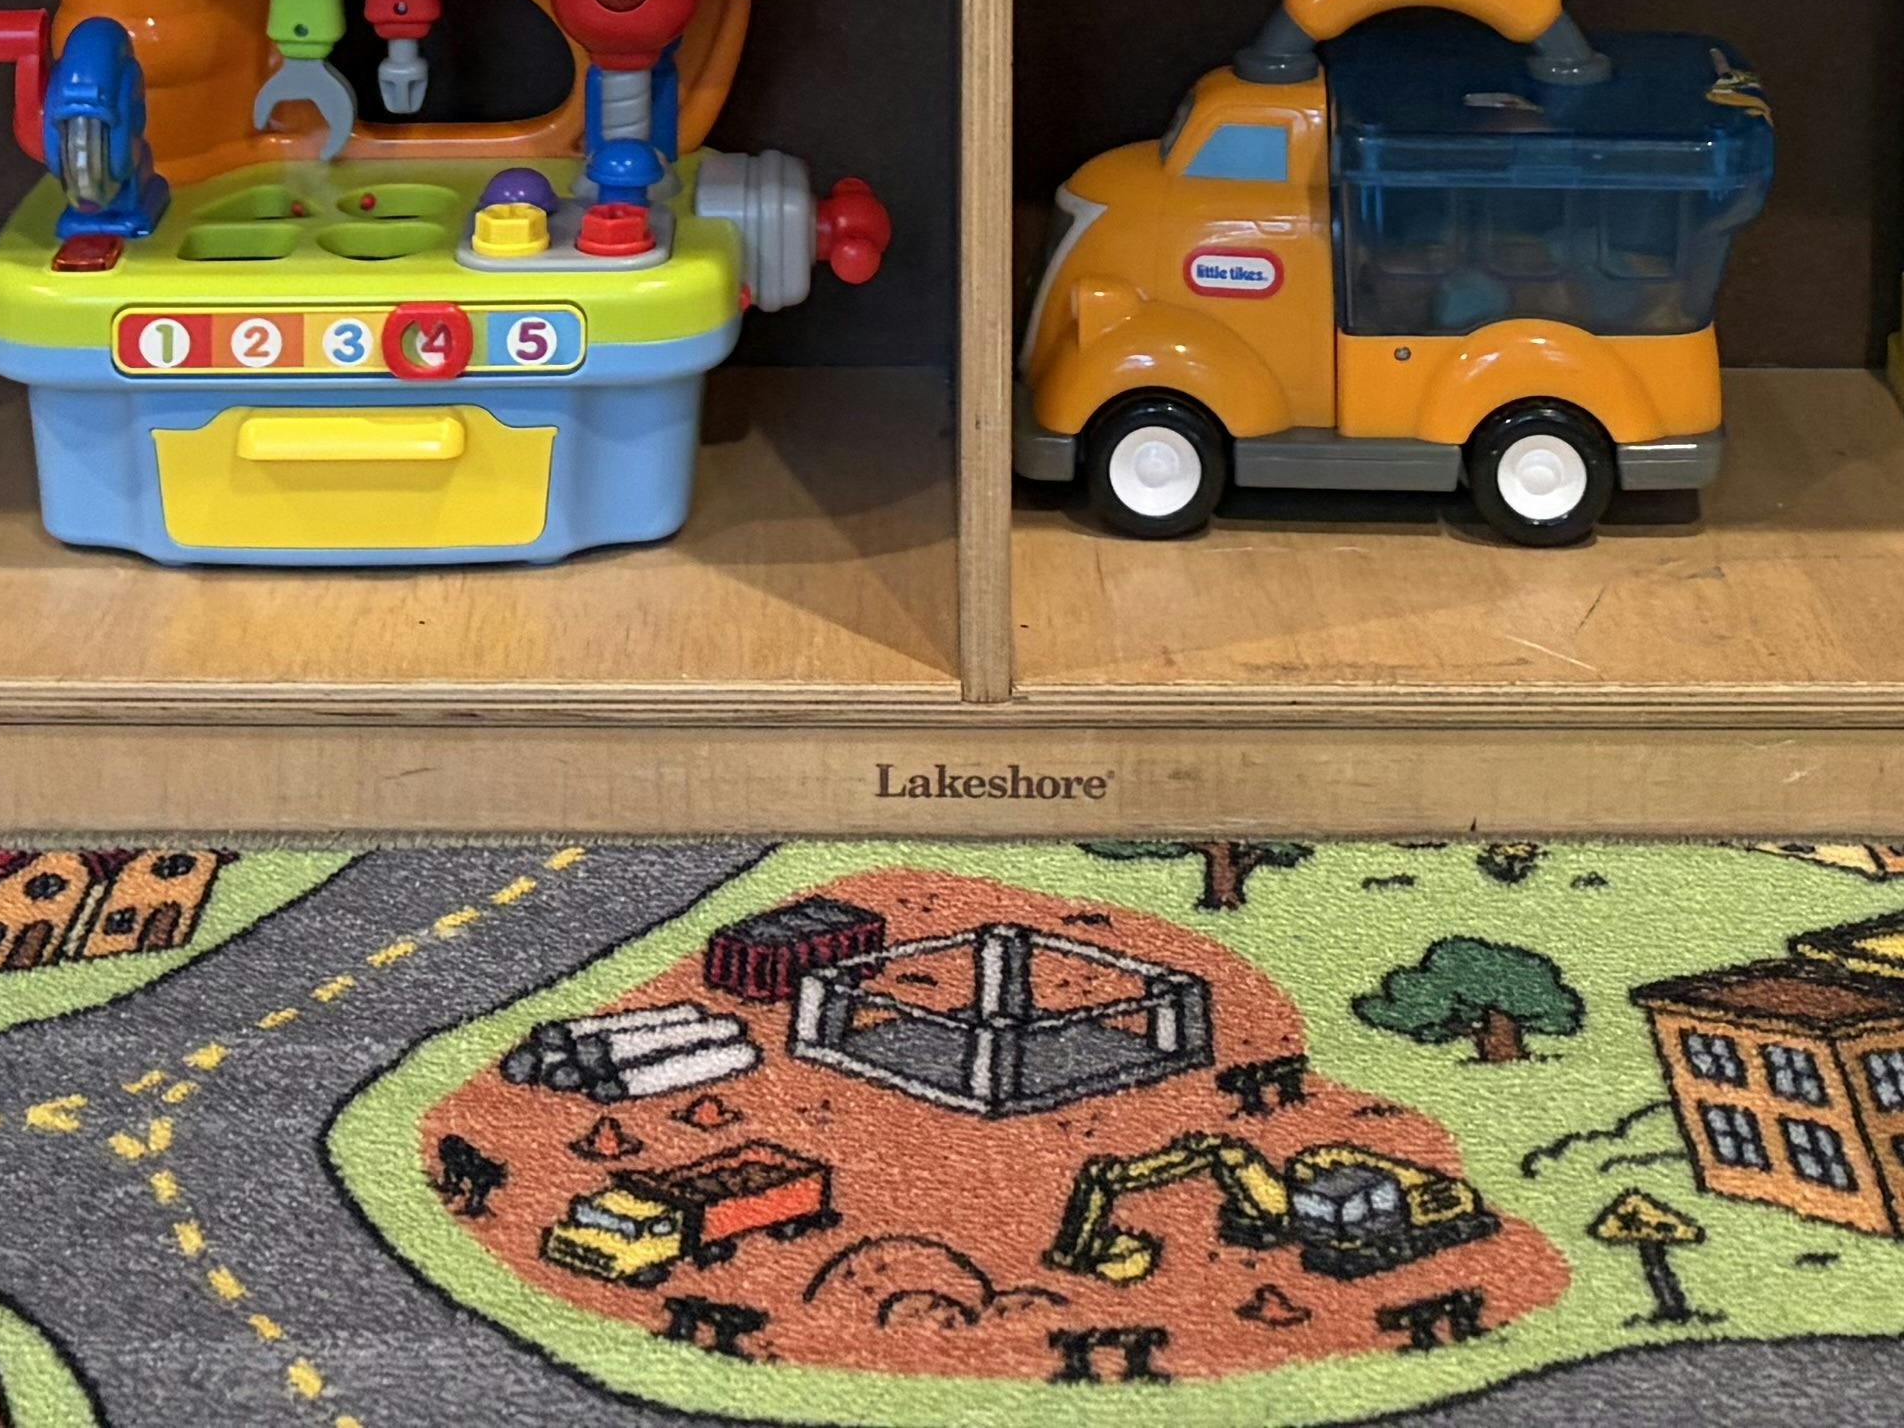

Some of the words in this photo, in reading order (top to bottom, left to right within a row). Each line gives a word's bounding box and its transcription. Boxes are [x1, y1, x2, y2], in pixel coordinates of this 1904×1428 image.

[1196, 263, 1228, 280] little
[156, 323, 173, 364] 1
[243, 326, 271, 359] 2
[332, 323, 365, 363] 3
[421, 321, 453, 358] 4
[516, 321, 549, 361] 5
[875, 763, 1108, 800] Lakeshore
